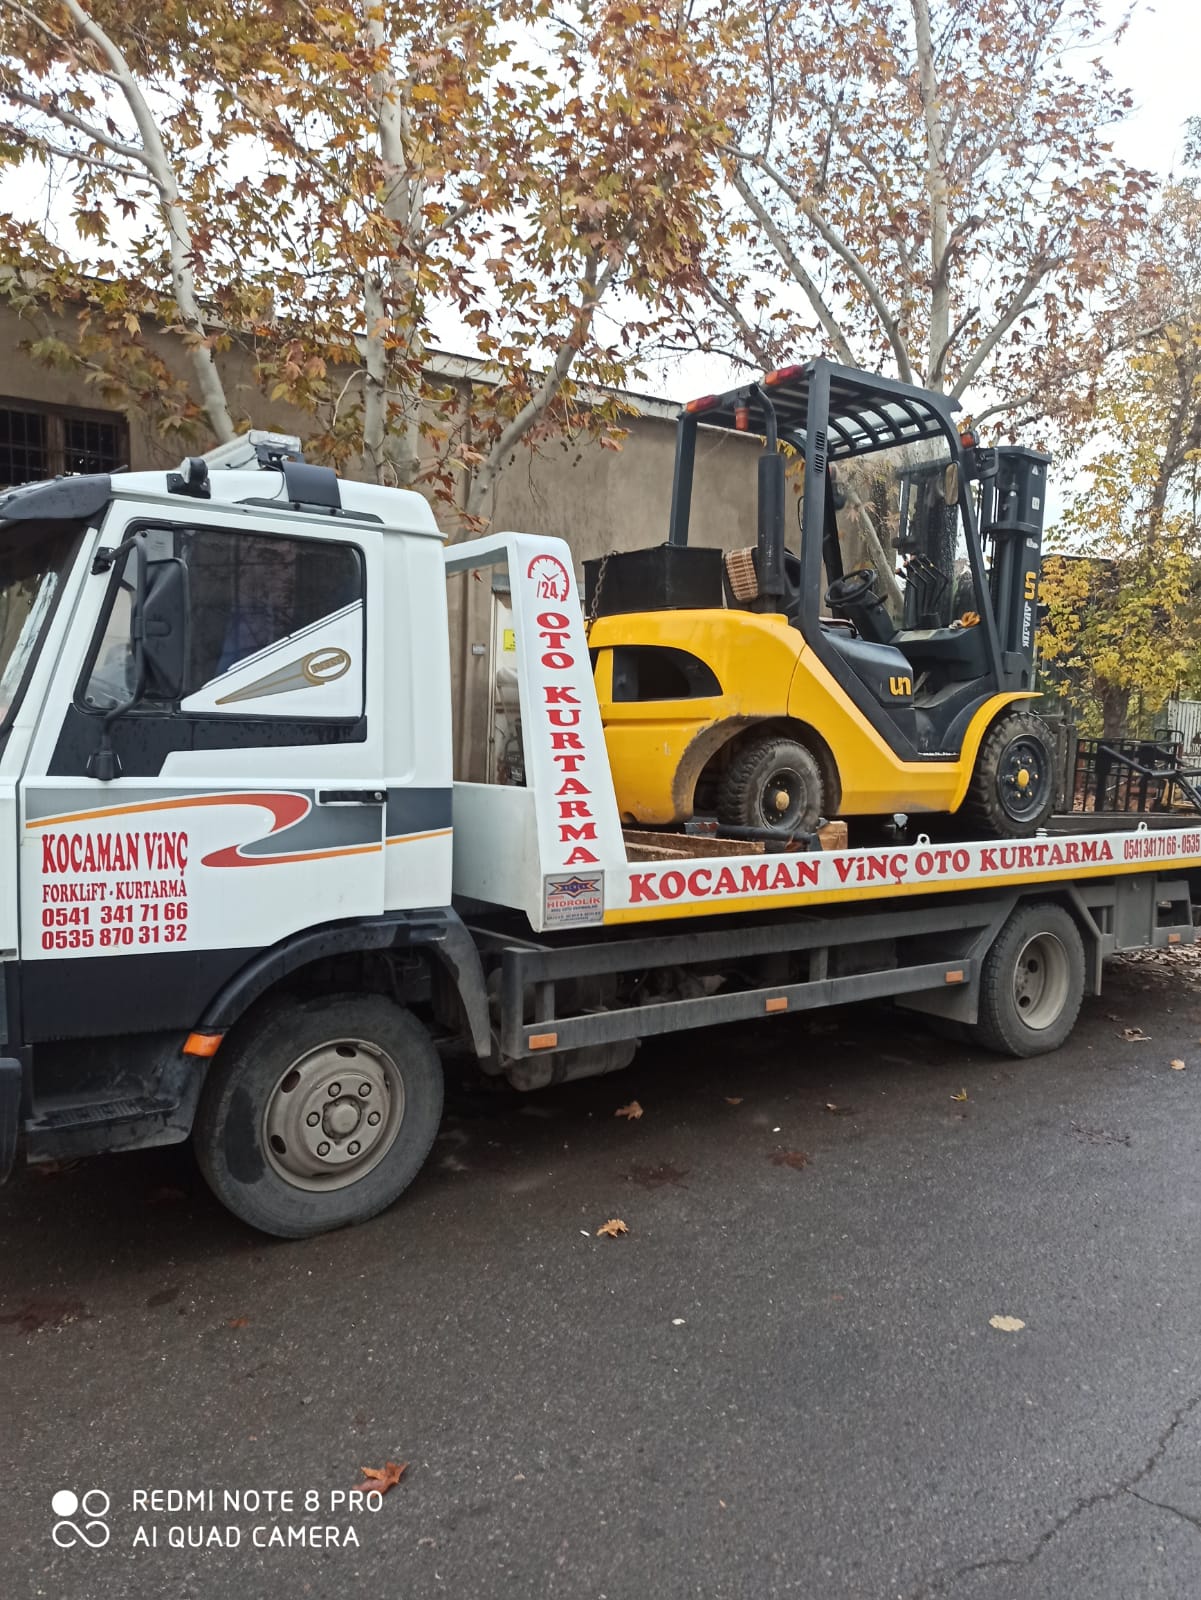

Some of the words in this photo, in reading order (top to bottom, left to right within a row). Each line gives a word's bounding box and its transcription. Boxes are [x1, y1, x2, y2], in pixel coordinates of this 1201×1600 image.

[536, 612, 574, 670] OTO
[543, 686, 600, 866] KURTARMA
[41, 833, 140, 874] KOCAMAN
[628, 860, 821, 904] KOCAMAN
[915, 849, 970, 876] OTO
[979, 840, 1113, 872] KURTARMA
[1182, 834, 1200, 854] 0535
[116, 879, 187, 900] KURTARMA
[42, 907, 90, 927] 0541
[101, 905, 133, 924] 341
[141, 904, 159, 922] 71
[164, 902, 188, 921] 66
[42, 928, 95, 950] 0535
[100, 927, 133, 946] 870
[139, 926, 159, 944] 31
[164, 924, 187, 942] 32
